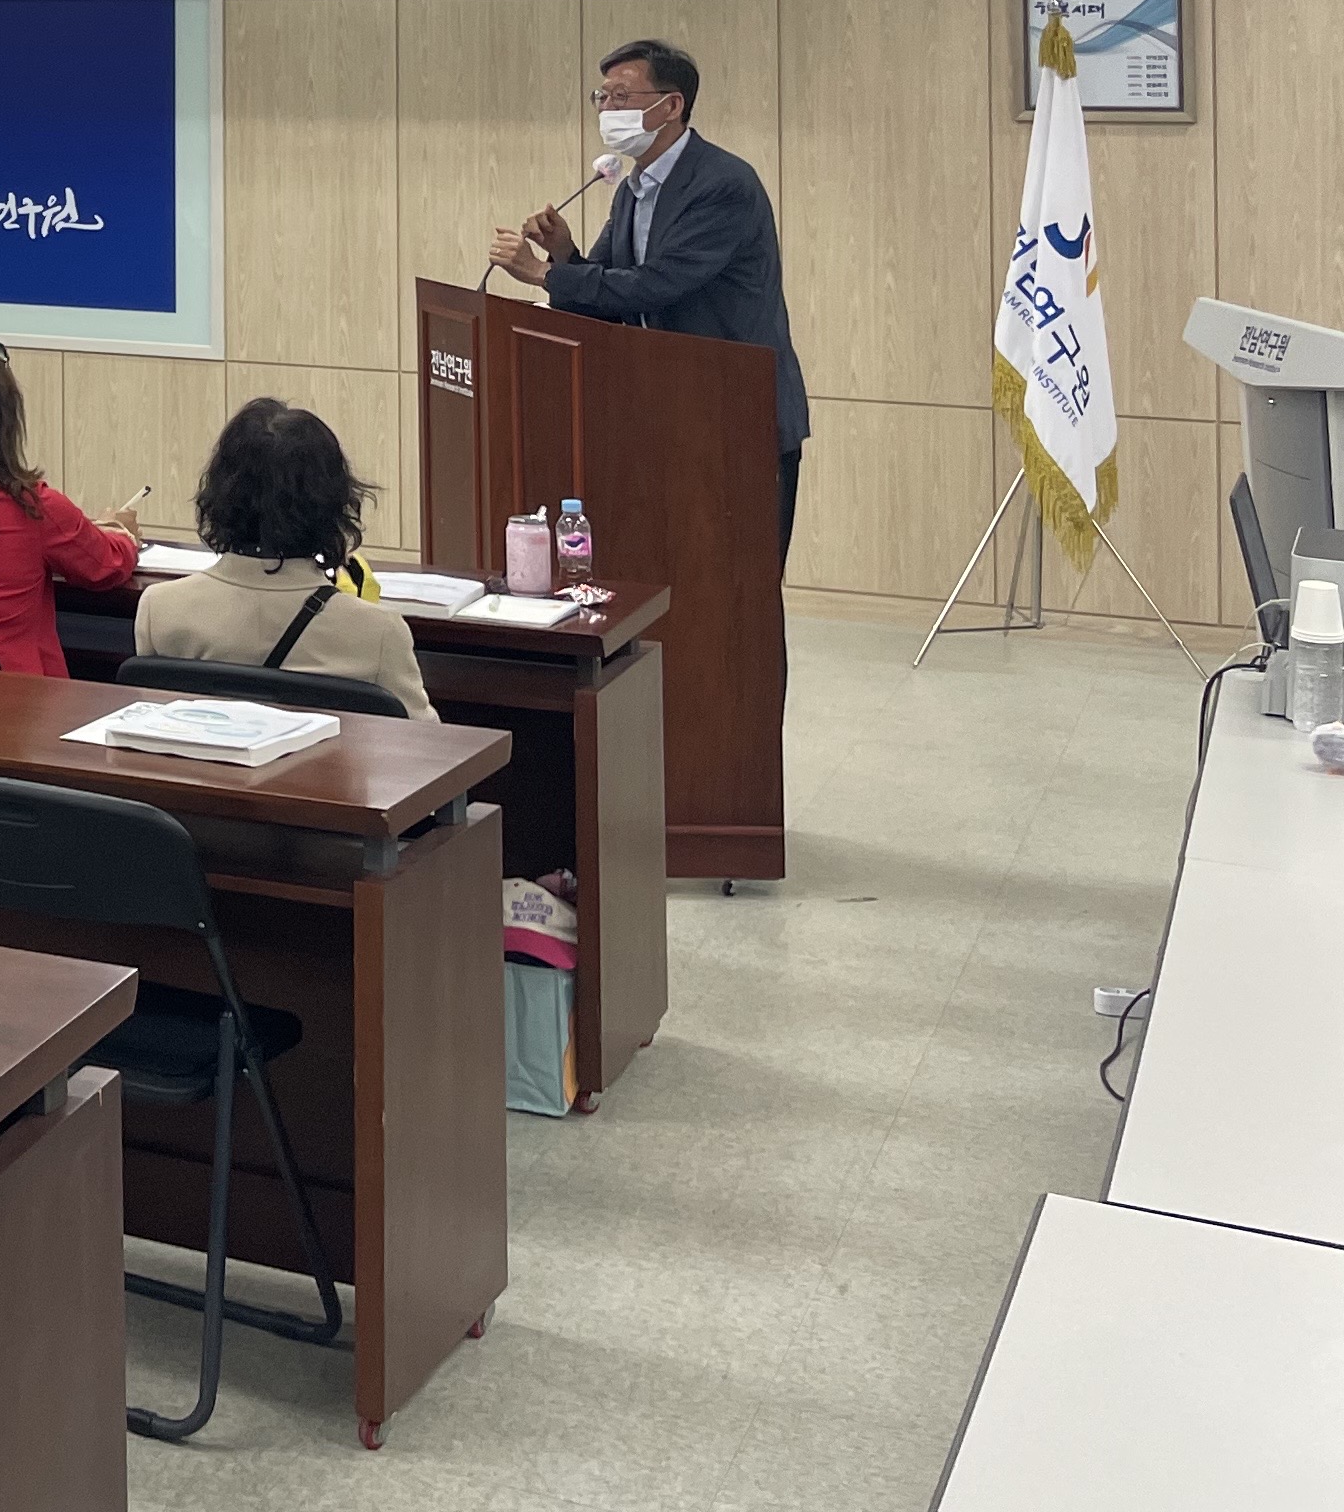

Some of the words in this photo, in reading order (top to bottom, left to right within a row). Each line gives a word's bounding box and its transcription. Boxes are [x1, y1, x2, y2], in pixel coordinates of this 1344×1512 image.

[1239, 326, 1291, 362] 전남연구원
[430, 349, 473, 386] 전남연구원
[1032, 366, 1079, 428] INSTITUTE
